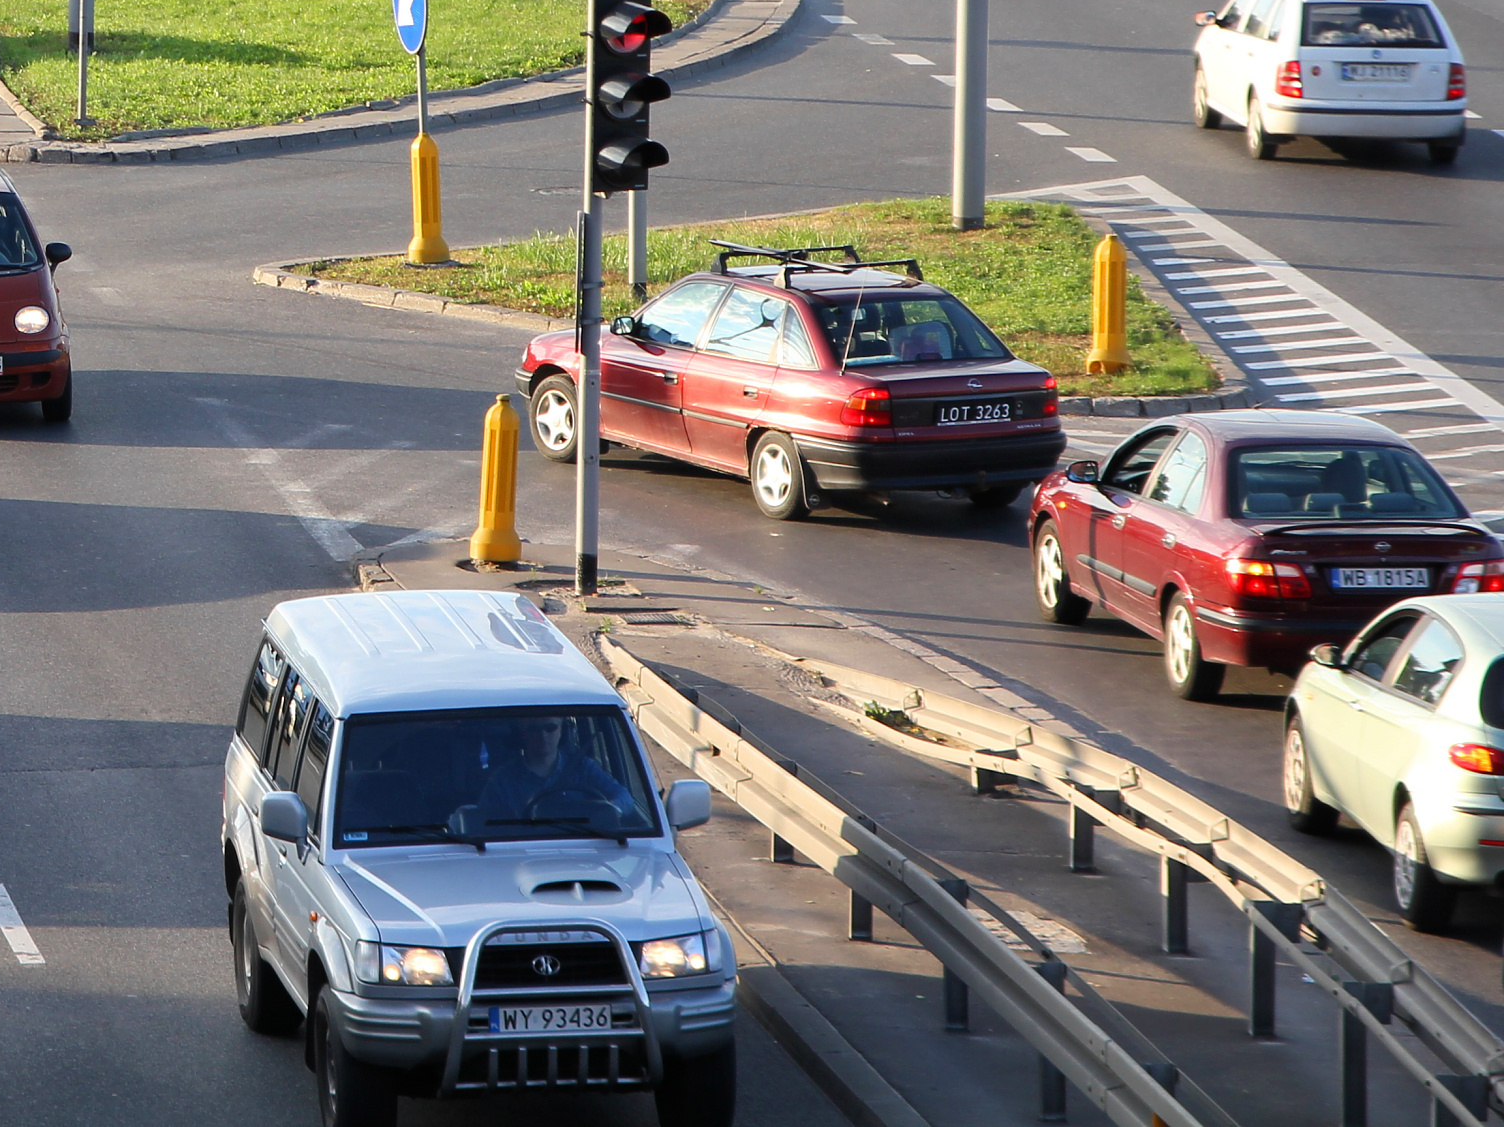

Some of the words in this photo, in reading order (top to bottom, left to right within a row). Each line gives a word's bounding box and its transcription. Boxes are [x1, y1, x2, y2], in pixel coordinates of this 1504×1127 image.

[941, 406, 970, 422] LOT
[975, 403, 1010, 419] 3263
[1343, 570, 1366, 585] WB
[1374, 569, 1427, 585] 1815A
[503, 1009, 533, 1030] WY
[541, 1006, 608, 1029] 93436
